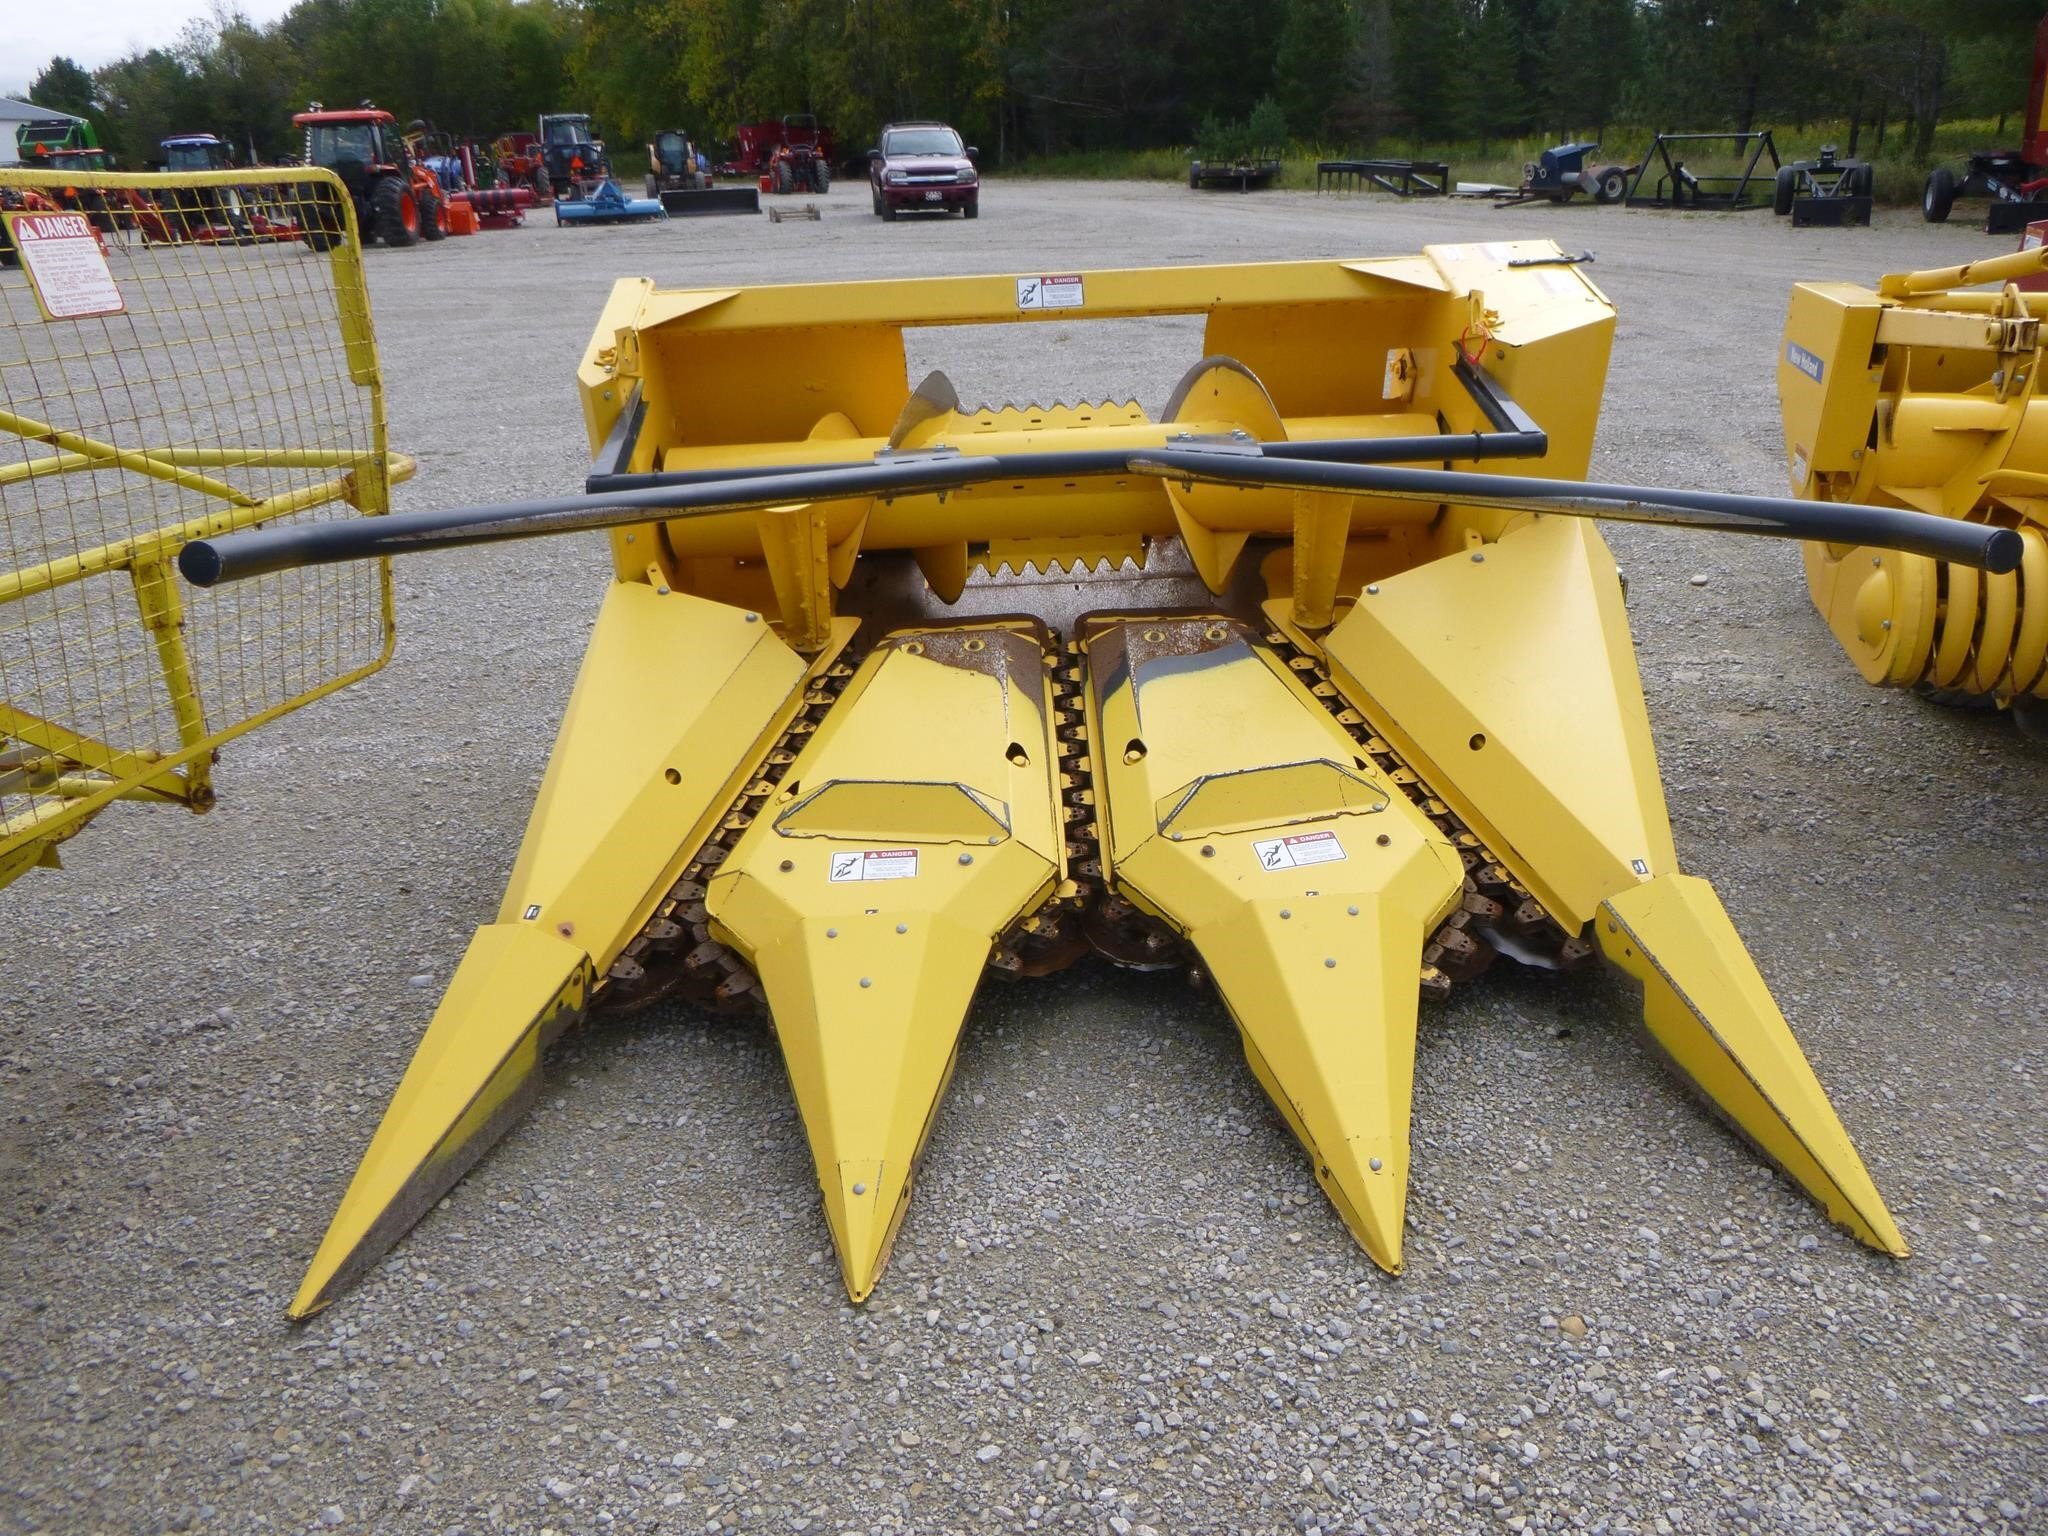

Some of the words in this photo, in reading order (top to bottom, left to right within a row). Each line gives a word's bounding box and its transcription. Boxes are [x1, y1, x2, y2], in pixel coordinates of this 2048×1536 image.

[34, 216, 91, 238] DANGER
[1791, 346, 1801, 367] New
[1801, 352, 1819, 377] Holland
[1299, 833, 1331, 842] DANGER
